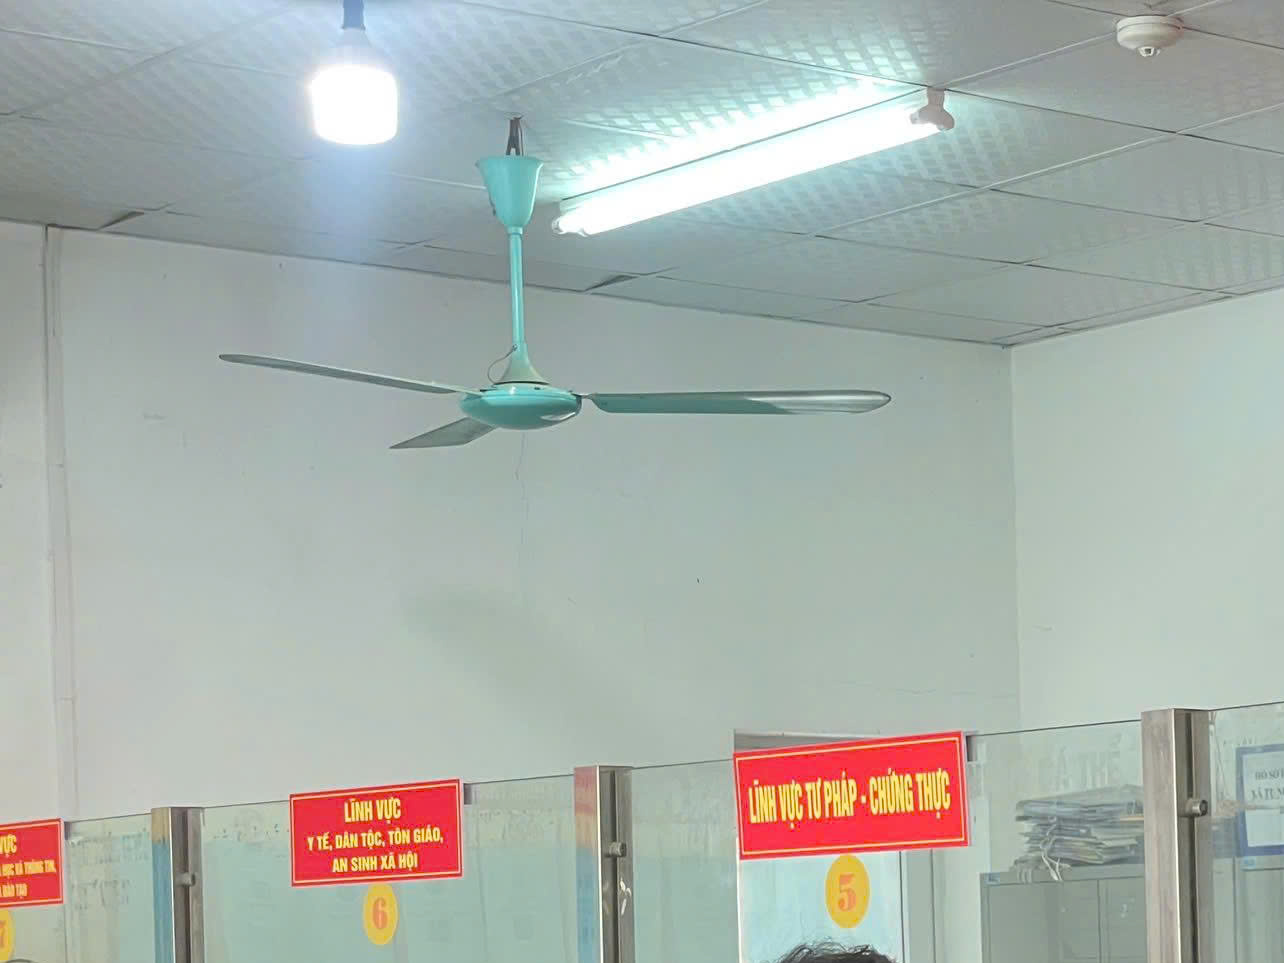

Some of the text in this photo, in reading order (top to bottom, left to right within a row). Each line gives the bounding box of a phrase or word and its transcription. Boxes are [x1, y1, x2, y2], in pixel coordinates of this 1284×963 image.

[344, 797, 402, 824] LĨNH VỰC
[748, 779, 777, 824] LĨNH
[778, 779, 804, 829] VỰC
[805, 777, 822, 820] TƯ
[823, 771, 857, 818] PHÁP
[869, 767, 914, 815] CHỨNG
[915, 767, 951, 819] THỰC
[307, 837, 315, 851] Y
[335, 830, 358, 849] DÂN
[361, 829, 386, 850] TỘC,
[388, 827, 411, 846] TÔN
[413, 824, 444, 844] GIÁO,
[332, 851, 418, 873] AN SINH XÃ HỘI
[837, 873, 857, 911] 5
[372, 897, 388, 930] 6
